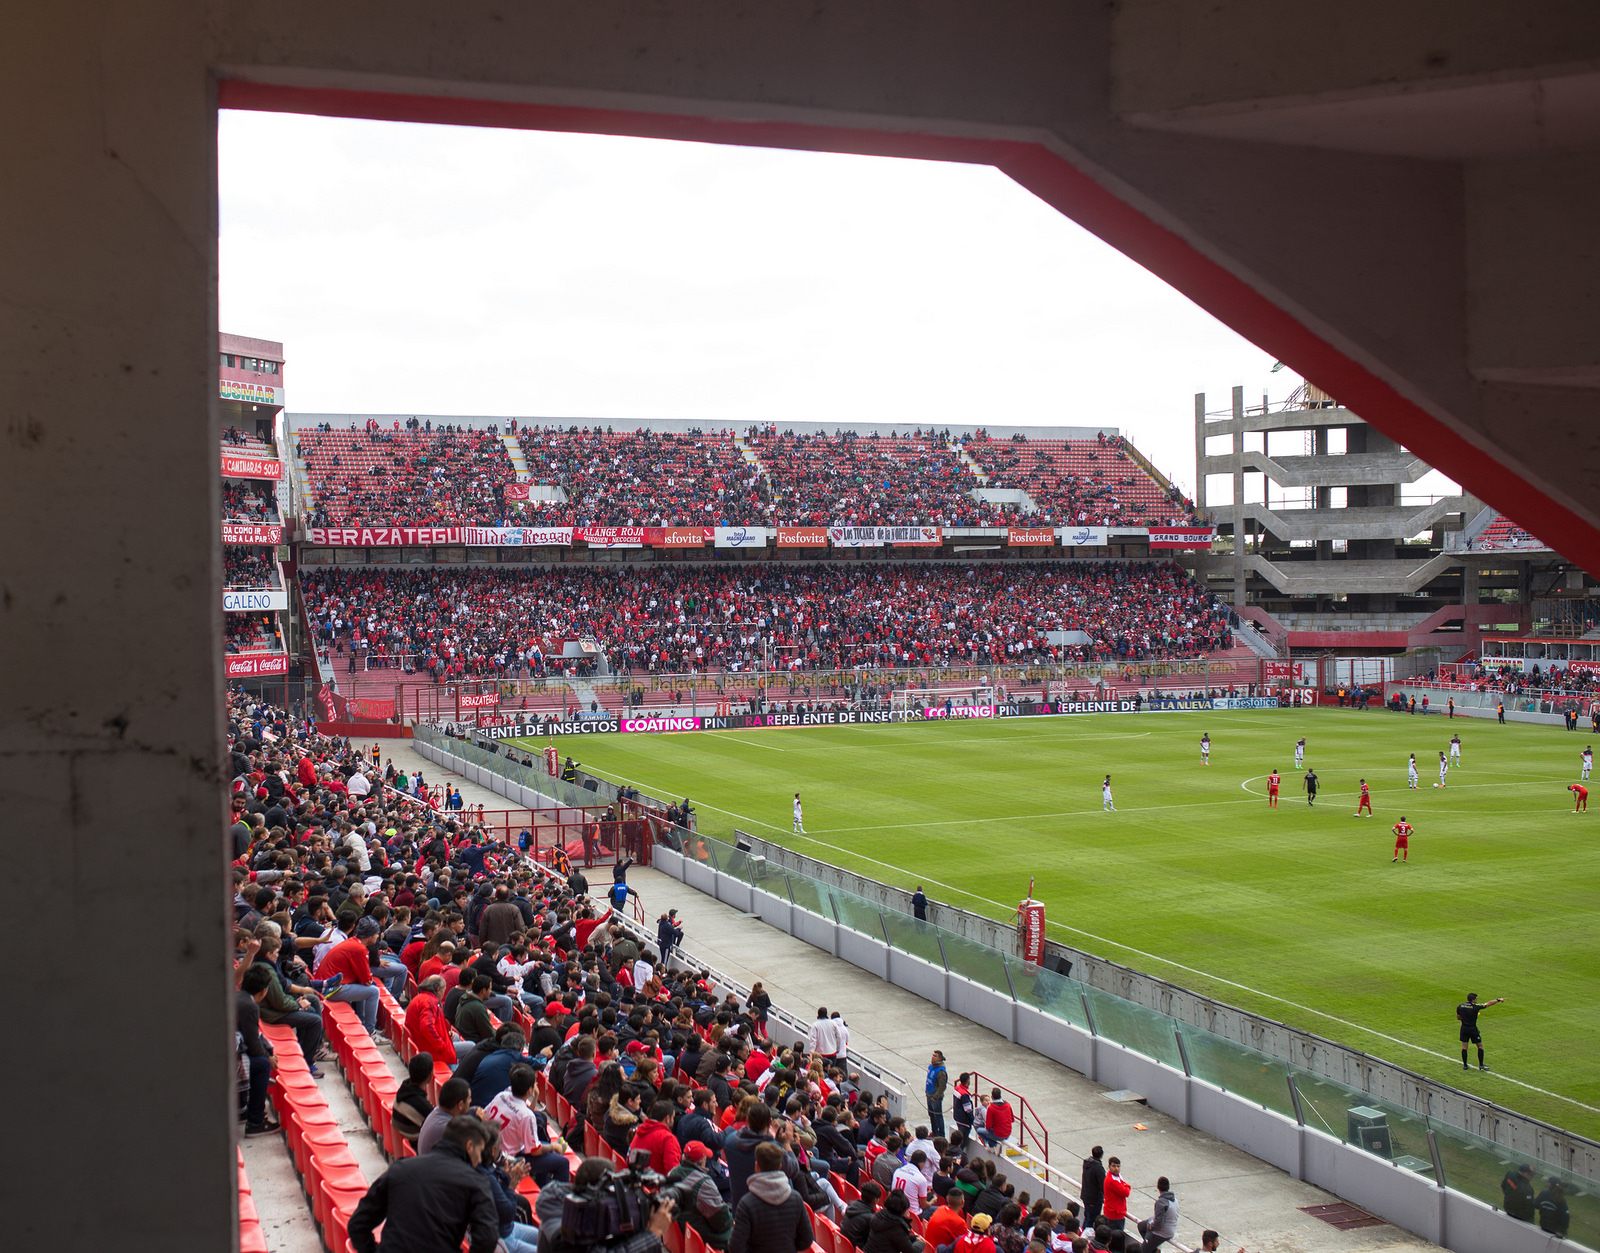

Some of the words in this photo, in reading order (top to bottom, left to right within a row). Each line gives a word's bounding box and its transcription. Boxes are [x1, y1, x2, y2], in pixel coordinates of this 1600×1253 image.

[219, 381, 275, 404] USMAR
[263, 463, 279, 475] SOLO
[311, 528, 466, 545] BERAZATEGUI
[522, 528, 571, 544] Reggae
[621, 528, 644, 536] ROJA
[779, 532, 825, 543] Fosfovita
[877, 528, 884, 540] de
[1009, 531, 1052, 542] Fosfovita
[224, 595, 271, 609] GALENO
[229, 660, 252, 673] Coca-Cola
[259, 658, 282, 672] Coca-Cola
[461, 694, 499, 706] BERAZATEGUI
[1160, 701, 1175, 710] LA
[1176, 700, 1212, 710] NUEVA
[525, 724, 544, 736] DE
[549, 720, 618, 735] INSECTOS
[625, 718, 700, 732] COATING.
[767, 711, 835, 727] REPEENTE
[839, 712, 856, 722] DE
[1121, 701, 1136, 711] DE
[1401, 825, 1405, 833] 3
[895, 1177, 907, 1191] 10
